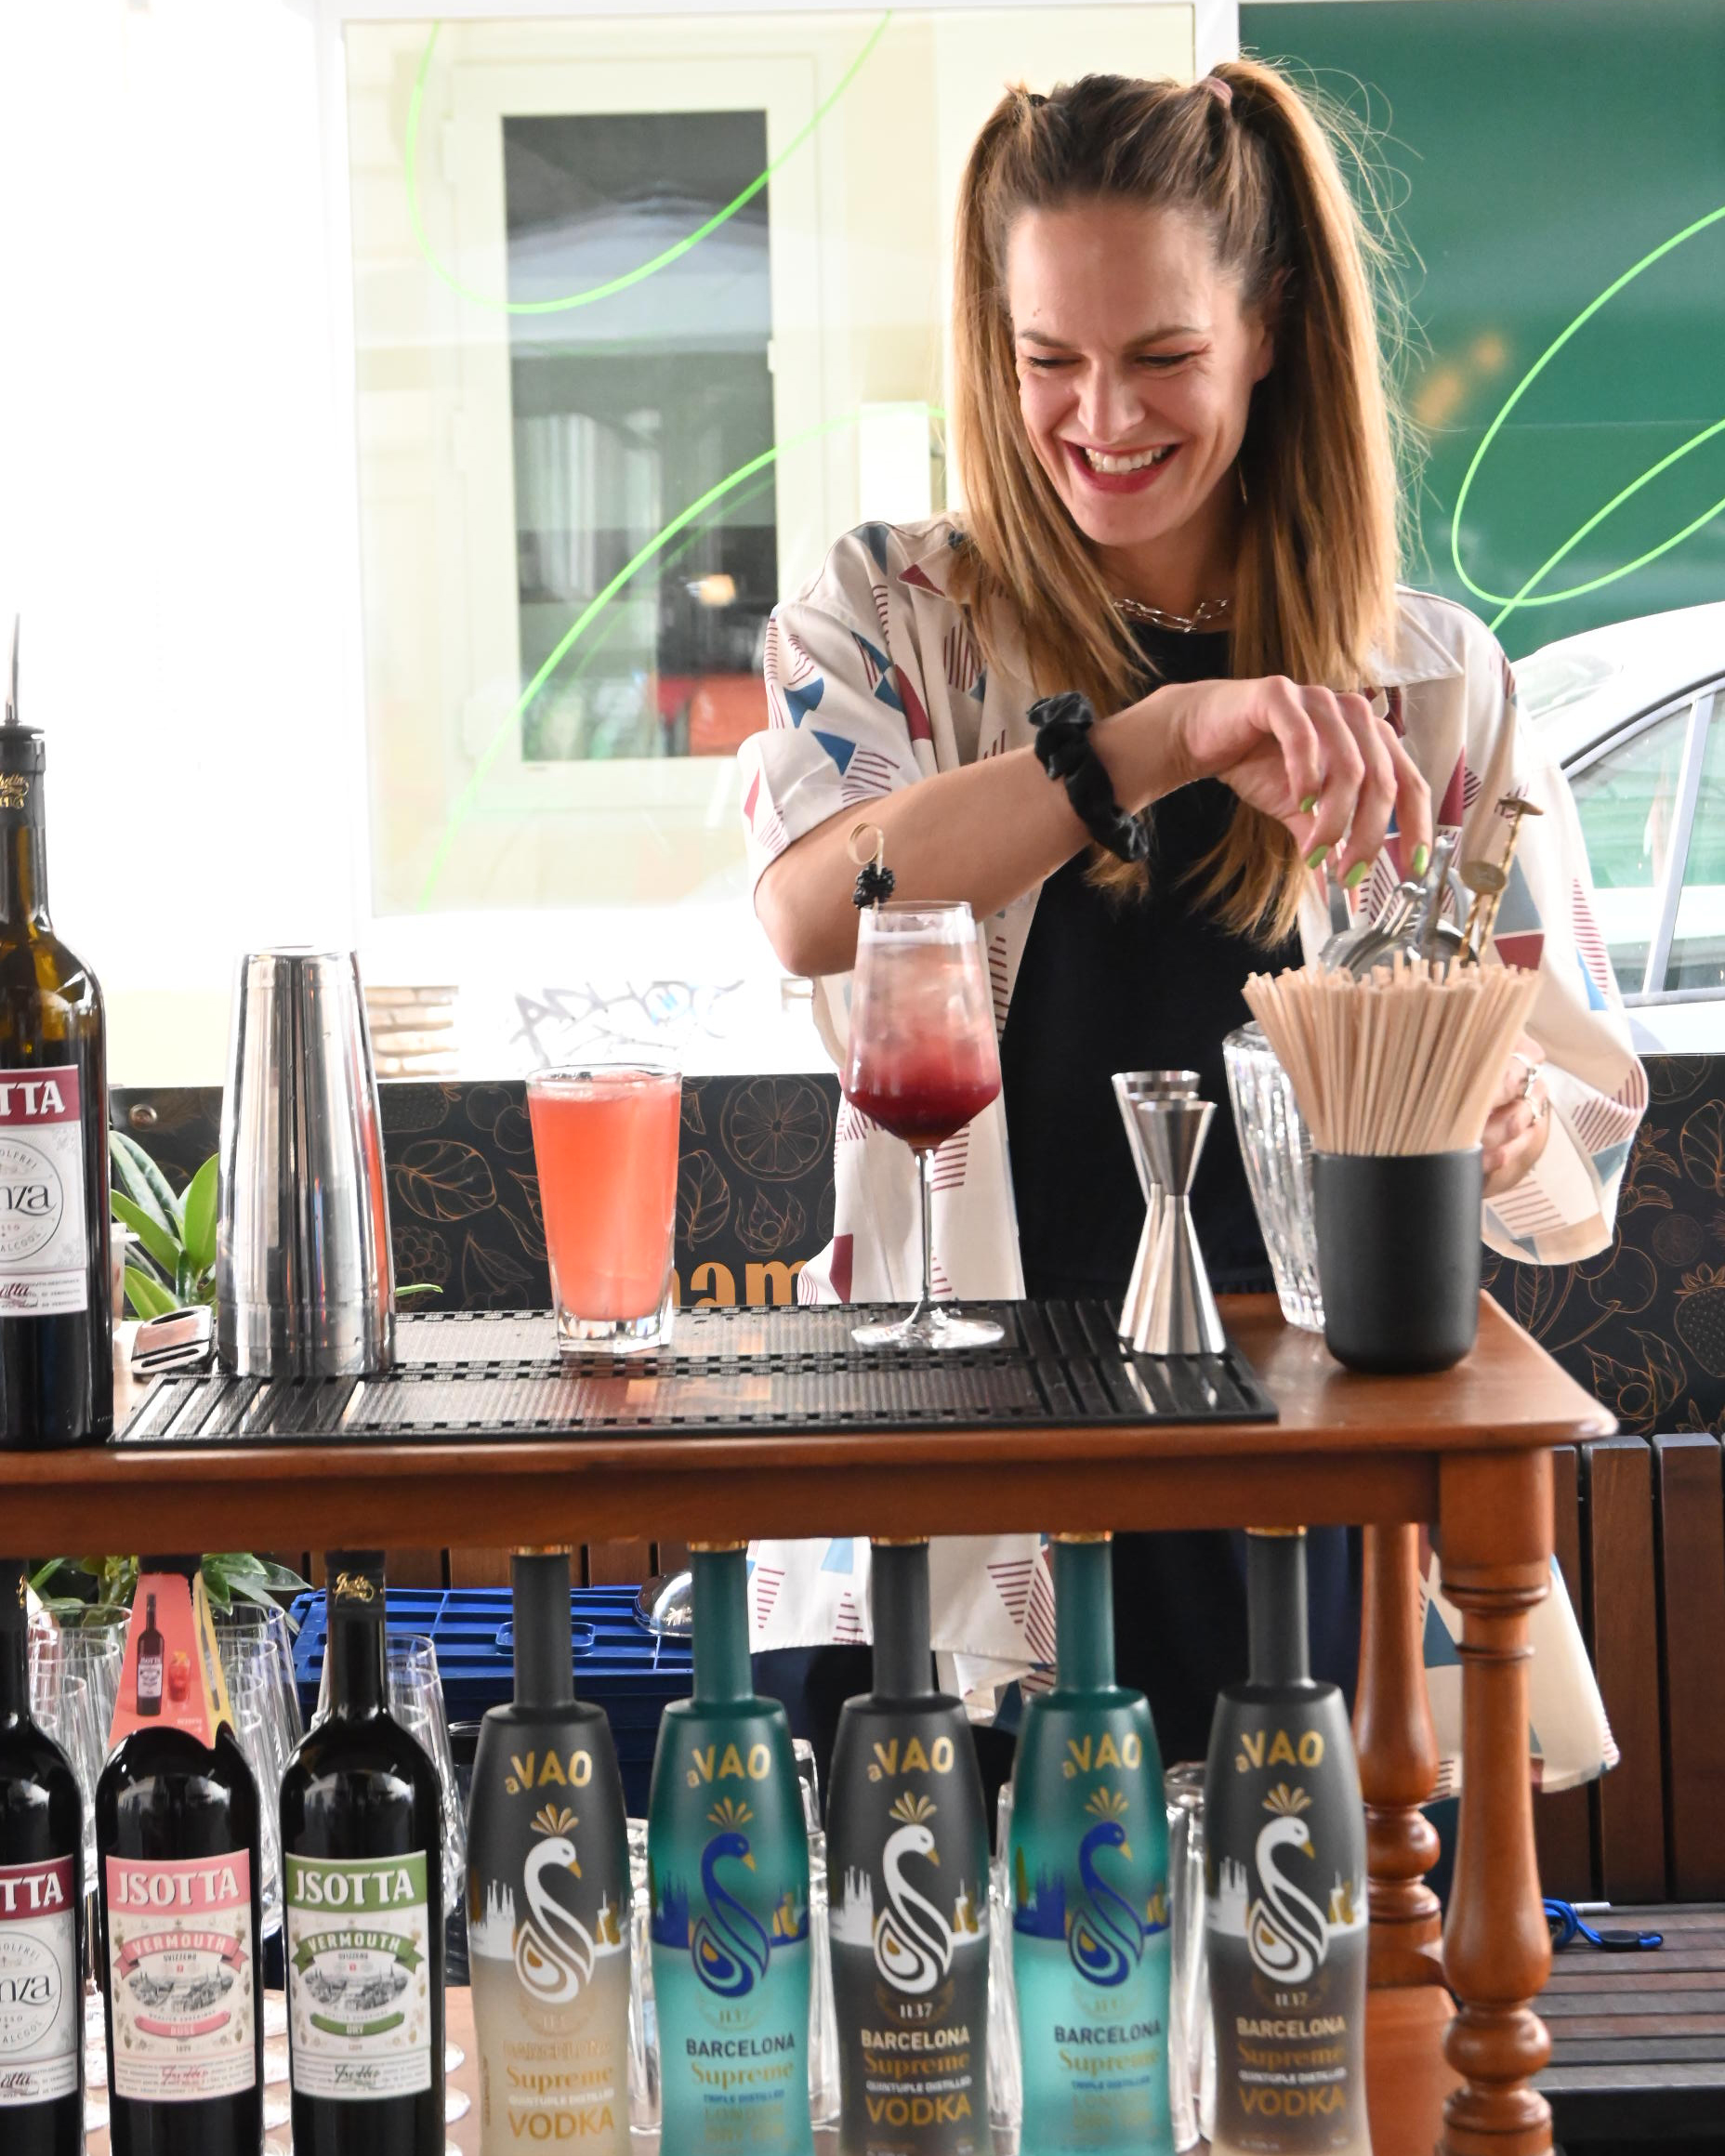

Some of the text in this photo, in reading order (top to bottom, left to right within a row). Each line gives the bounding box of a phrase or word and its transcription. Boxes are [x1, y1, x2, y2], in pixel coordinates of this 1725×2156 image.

[132, 1933, 227, 1955] VERMOUTH
[307, 1931, 402, 1953] VERMOUTH
[861, 2025, 970, 2051] BARCELONA
[1054, 2019, 1161, 2044] BARCELONA
[1236, 2015, 1347, 2039] BARCELONA
[686, 2031, 795, 2058] BARCELONA
[863, 2051, 970, 2080] Supreme
[865, 2094, 972, 2127] VODKA
[1239, 2084, 1348, 2117] VODKA
[507, 2102, 615, 2140] VODKA
